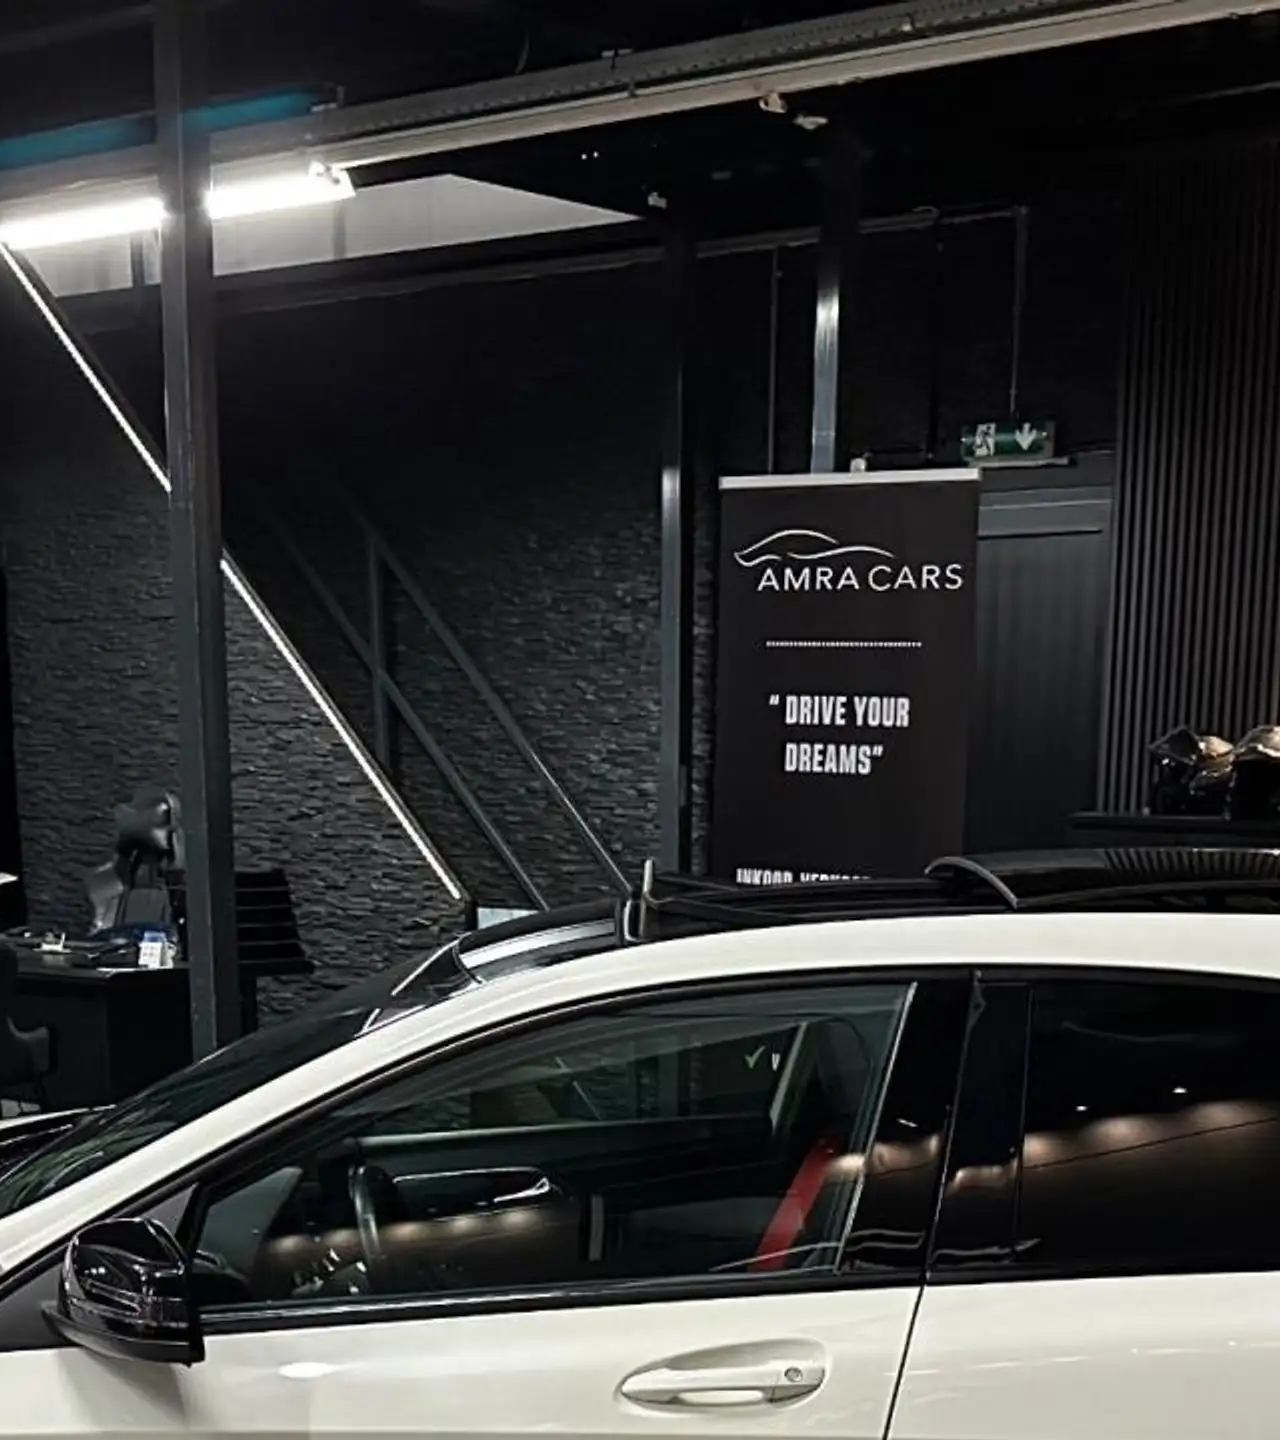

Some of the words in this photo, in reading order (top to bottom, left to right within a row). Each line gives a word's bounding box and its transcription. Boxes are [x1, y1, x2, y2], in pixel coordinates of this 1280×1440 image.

[756, 565, 860, 592] AMRA
[867, 563, 965, 592] CARS
[853, 696, 910, 729] YOUR
